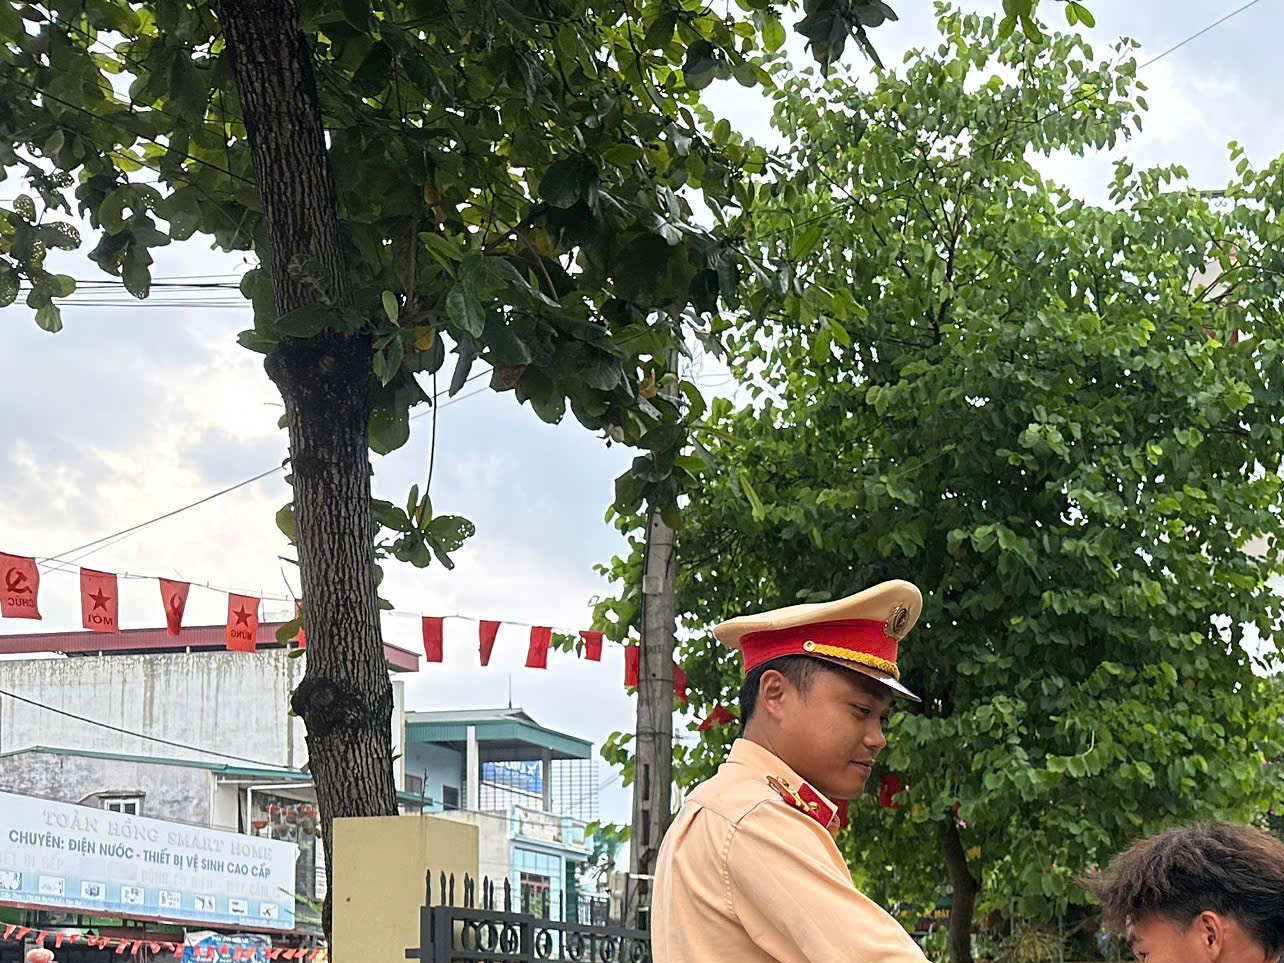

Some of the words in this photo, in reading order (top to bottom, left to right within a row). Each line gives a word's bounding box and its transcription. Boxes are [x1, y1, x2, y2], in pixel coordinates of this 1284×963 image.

[9, 829, 64, 849] CHUYÊN:
[68, 837, 95, 856] ĐIỆN
[99, 842, 134, 859] NƯỚC
[143, 848, 171, 865] THIẾT
[174, 855, 183, 870] BỊ
[186, 854, 199, 872] VỆ
[201, 858, 224, 872] SINH
[227, 862, 249, 875] CAO
[251, 862, 271, 879] CẤP
[167, 831, 224, 853] SMART
[231, 841, 272, 861] HOME
